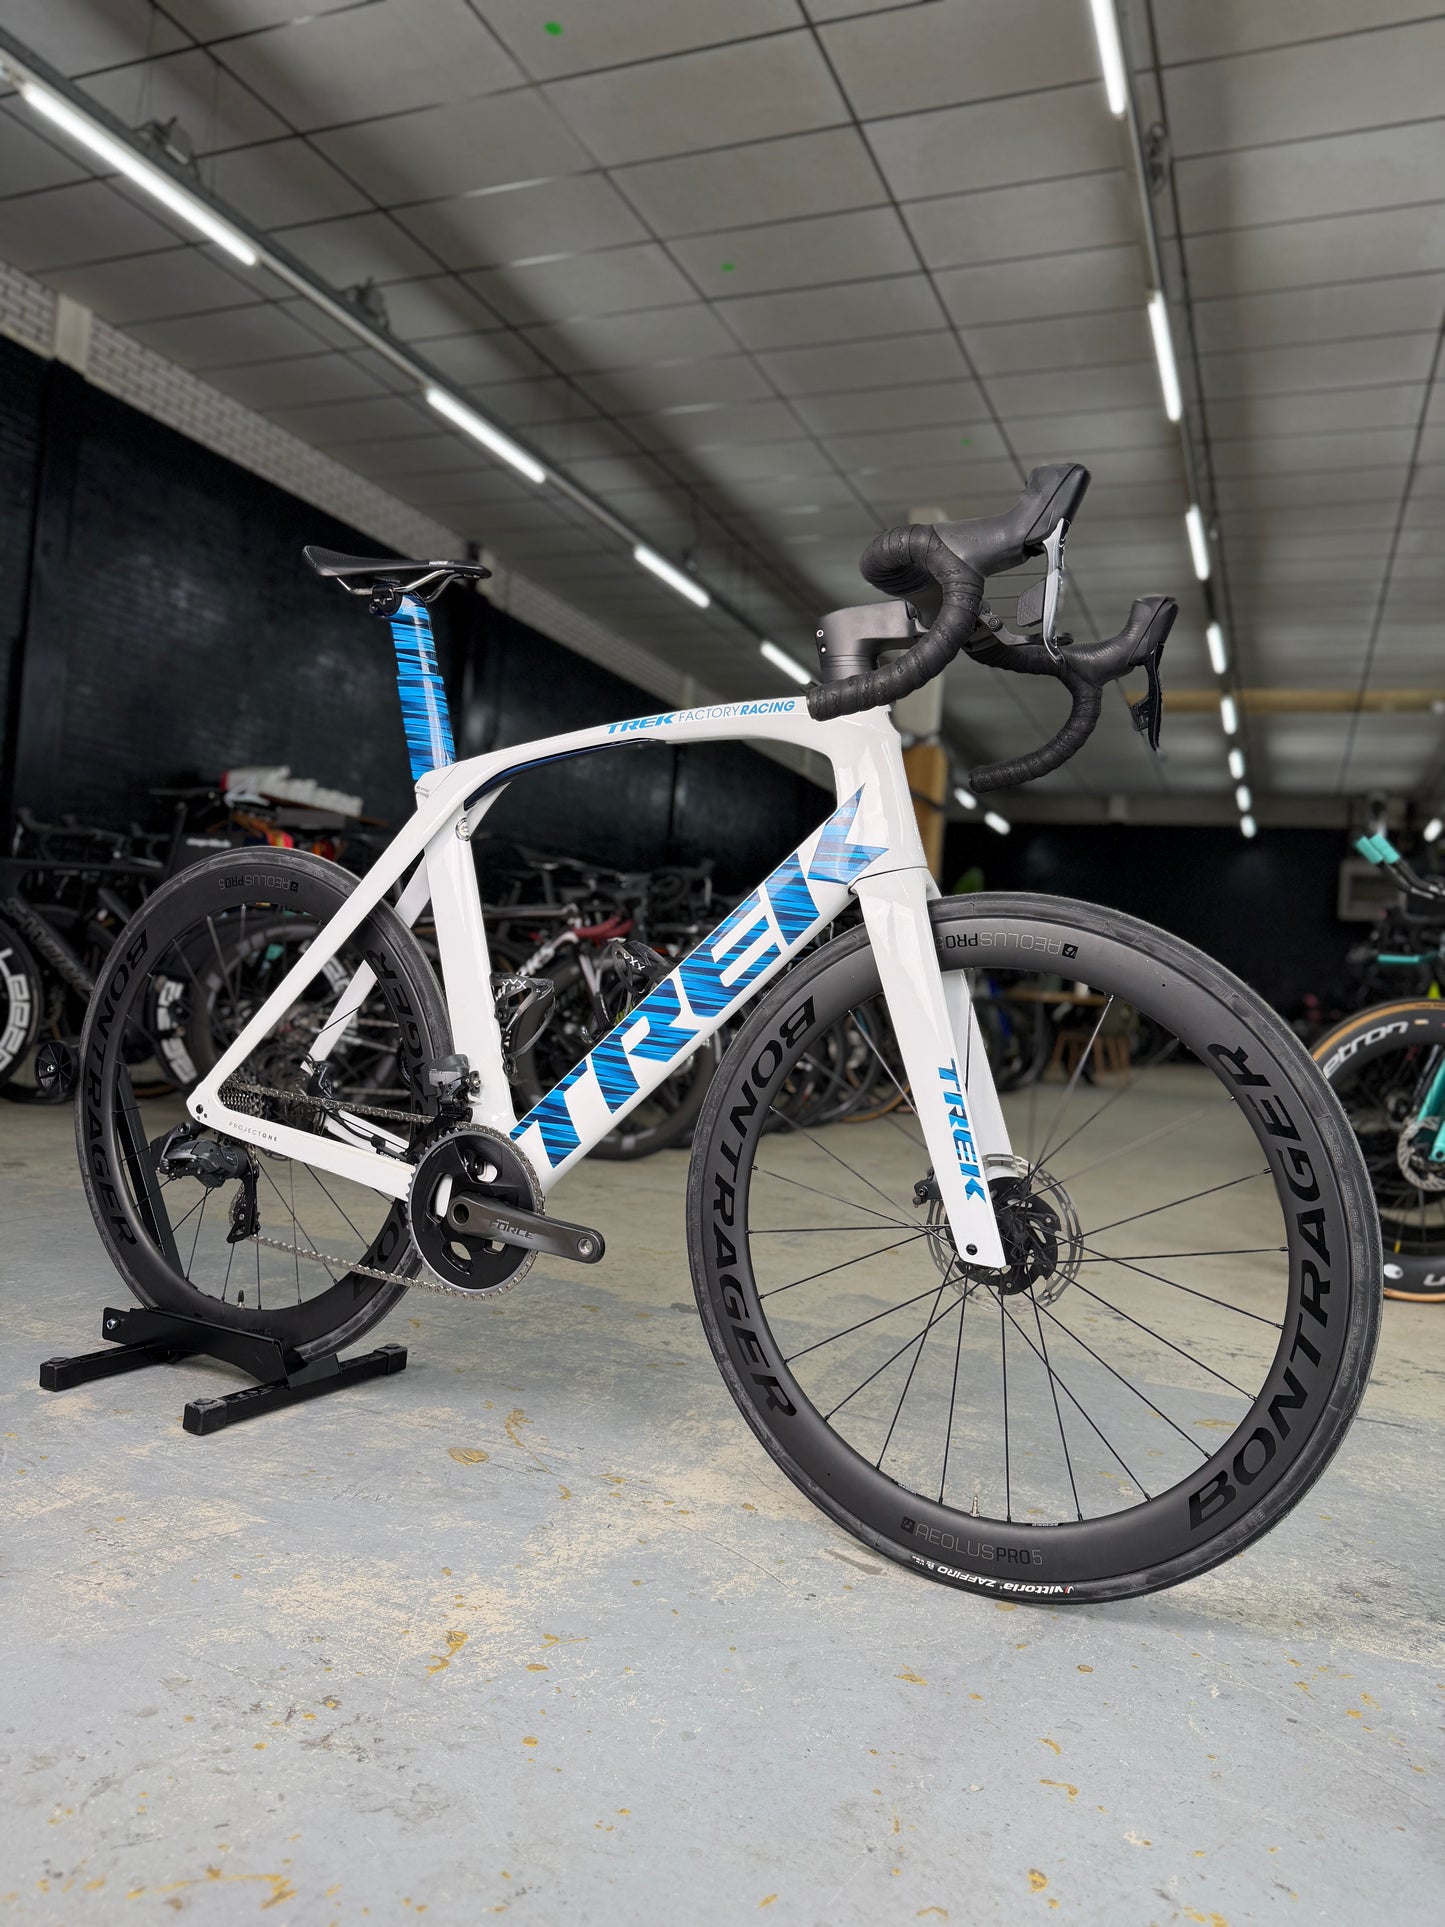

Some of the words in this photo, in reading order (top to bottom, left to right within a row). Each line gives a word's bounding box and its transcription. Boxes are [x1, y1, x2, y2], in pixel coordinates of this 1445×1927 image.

[606, 713, 677, 734] TREK
[88, 927, 149, 1248] BONTRAGER
[510, 783, 889, 1168] TREK
[937, 1057, 987, 1205] TREK
[707, 996, 817, 1418] BONTRAGER
[1188, 1042, 1334, 1529] BONTRAGER
[937, 1565, 997, 1589] ZAFFIRO
